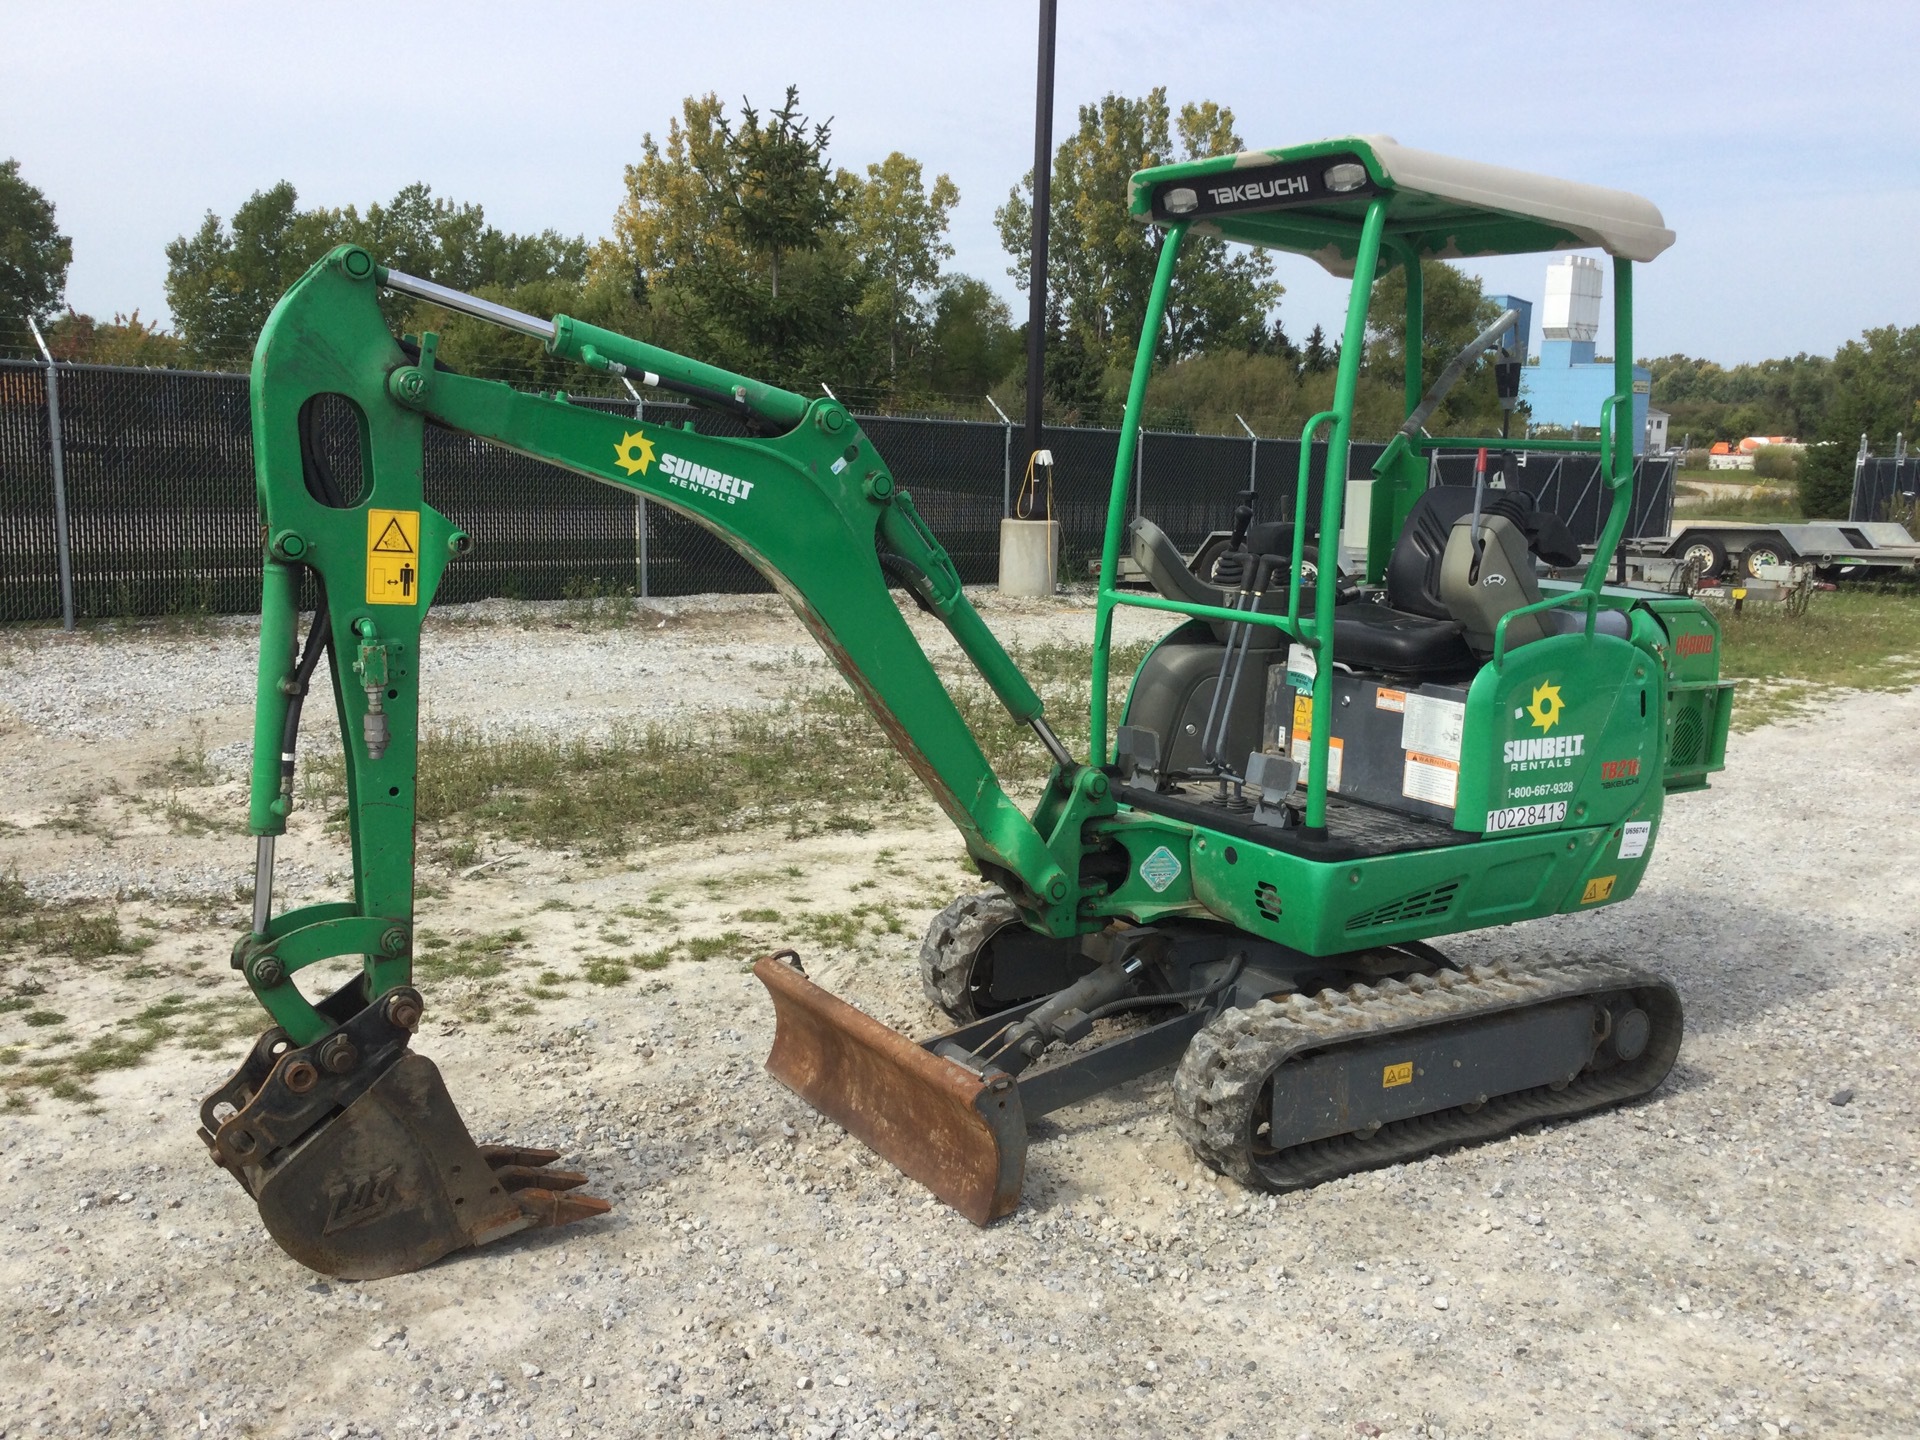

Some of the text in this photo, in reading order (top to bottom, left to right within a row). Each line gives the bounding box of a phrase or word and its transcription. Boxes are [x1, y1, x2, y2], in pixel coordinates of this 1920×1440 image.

[1208, 175, 1308, 204] TAKEUCHI
[659, 452, 755, 500] SUNBELT
[669, 476, 736, 505] RENTALS
[1675, 632, 1714, 659] HYBRID
[1418, 756, 1452, 769] WARNING
[1503, 734, 1584, 764] SUNBELT
[1511, 758, 1572, 772] RENTALS
[1507, 782, 1574, 799] 1-800-667-9328
[1488, 802, 1567, 831] 10228413
